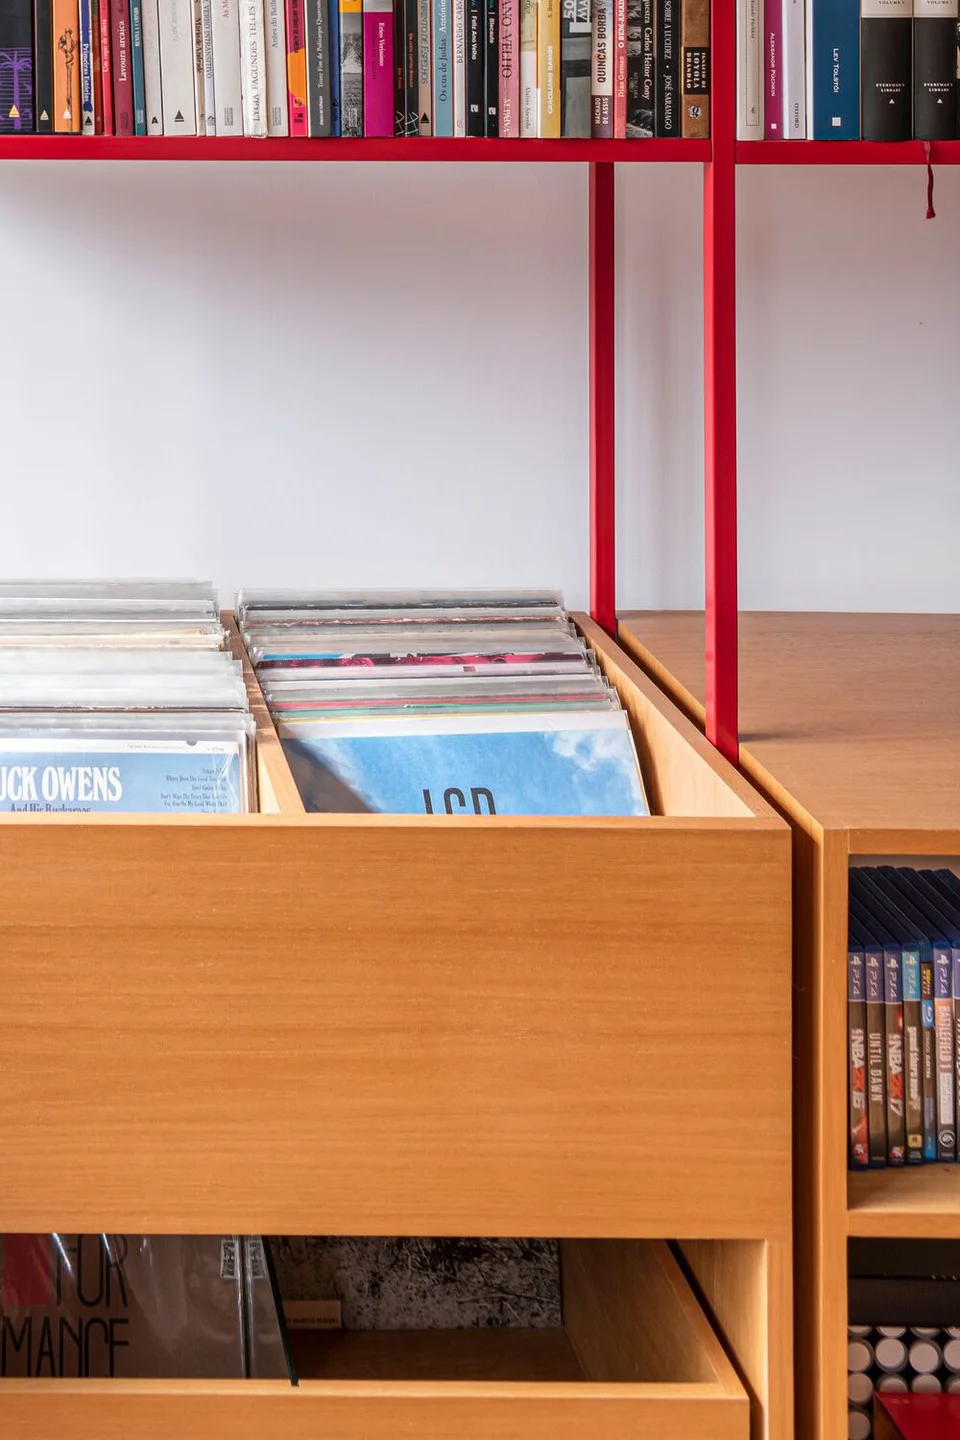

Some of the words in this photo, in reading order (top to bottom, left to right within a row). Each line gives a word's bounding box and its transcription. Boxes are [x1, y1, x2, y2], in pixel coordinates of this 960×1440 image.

[597, 8, 606, 39] BORBA
[82, 43, 90, 75] Primeiras
[501, 34, 513, 79] VELHO
[597, 41, 606, 83] QUINCAS
[693, 52, 701, 89] LOYOLA
[42, 767, 122, 801] OWENS
[869, 1033, 881, 1065] UNTIL
[870, 1069, 882, 1101] DAWN
